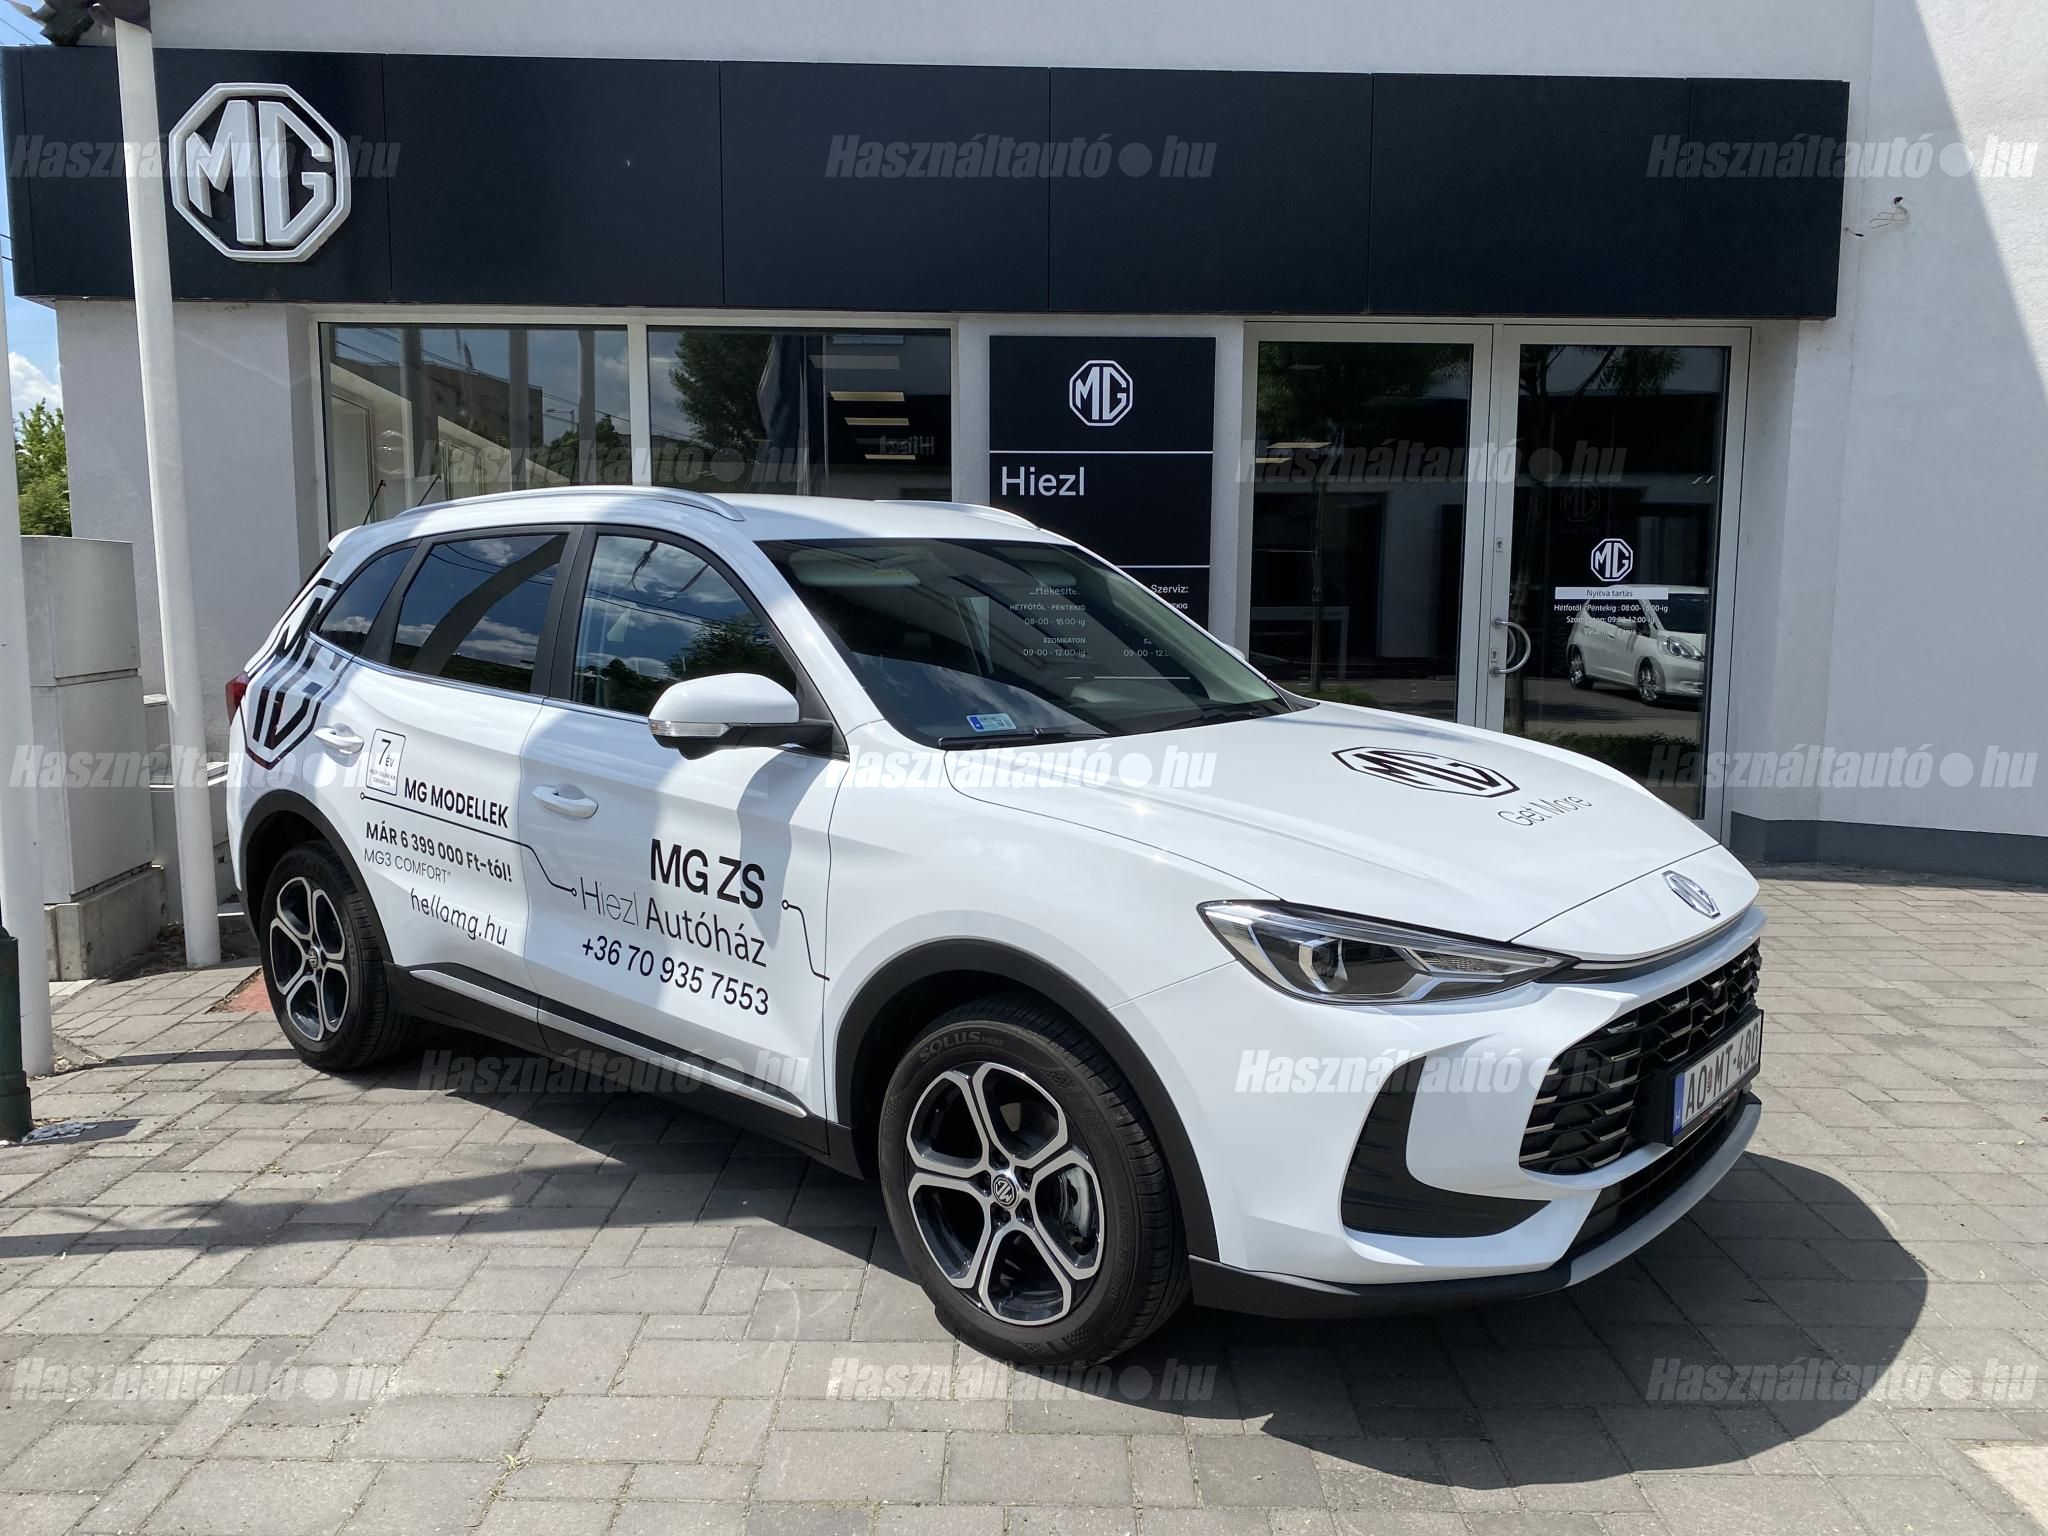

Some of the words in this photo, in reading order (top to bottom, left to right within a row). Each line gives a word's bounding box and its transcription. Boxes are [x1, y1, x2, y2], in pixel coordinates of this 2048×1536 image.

[186, 99, 334, 247] MG
[1075, 366, 1127, 420] MG
[1001, 466, 1085, 496] Hiezl
[1594, 542, 1630, 578] MG
[1151, 584, 1189, 594] Szerviz:
[1586, 590, 1610, 598] Nyitva
[378, 738, 392, 766] 7
[1352, 750, 1502, 792] MG
[404, 777, 428, 803] MG
[431, 785, 509, 829] MODELLEK
[1498, 806, 1552, 826] Get
[1528, 796, 1593, 816] More
[364, 847, 392, 867] MG3
[366, 820, 398, 846] MÁR
[400, 830, 409, 849] 6
[412, 833, 435, 857] 399
[438, 842, 464, 866] 000
[466, 851, 513, 883] Ft-tól!
[651, 838, 709, 896] MG
[717, 855, 765, 910] ZS
[410, 888, 508, 946] hellomg.hu
[580, 876, 639, 927] Hiezl
[646, 897, 767, 968] Autóház
[582, 935, 622, 966] +36
[628, 944, 654, 977] 70
[659, 956, 704, 994] 935
[711, 971, 769, 1016] 7553
[919, 1031, 981, 1063] SOLUS
[1686, 1064, 1708, 1119] AO
